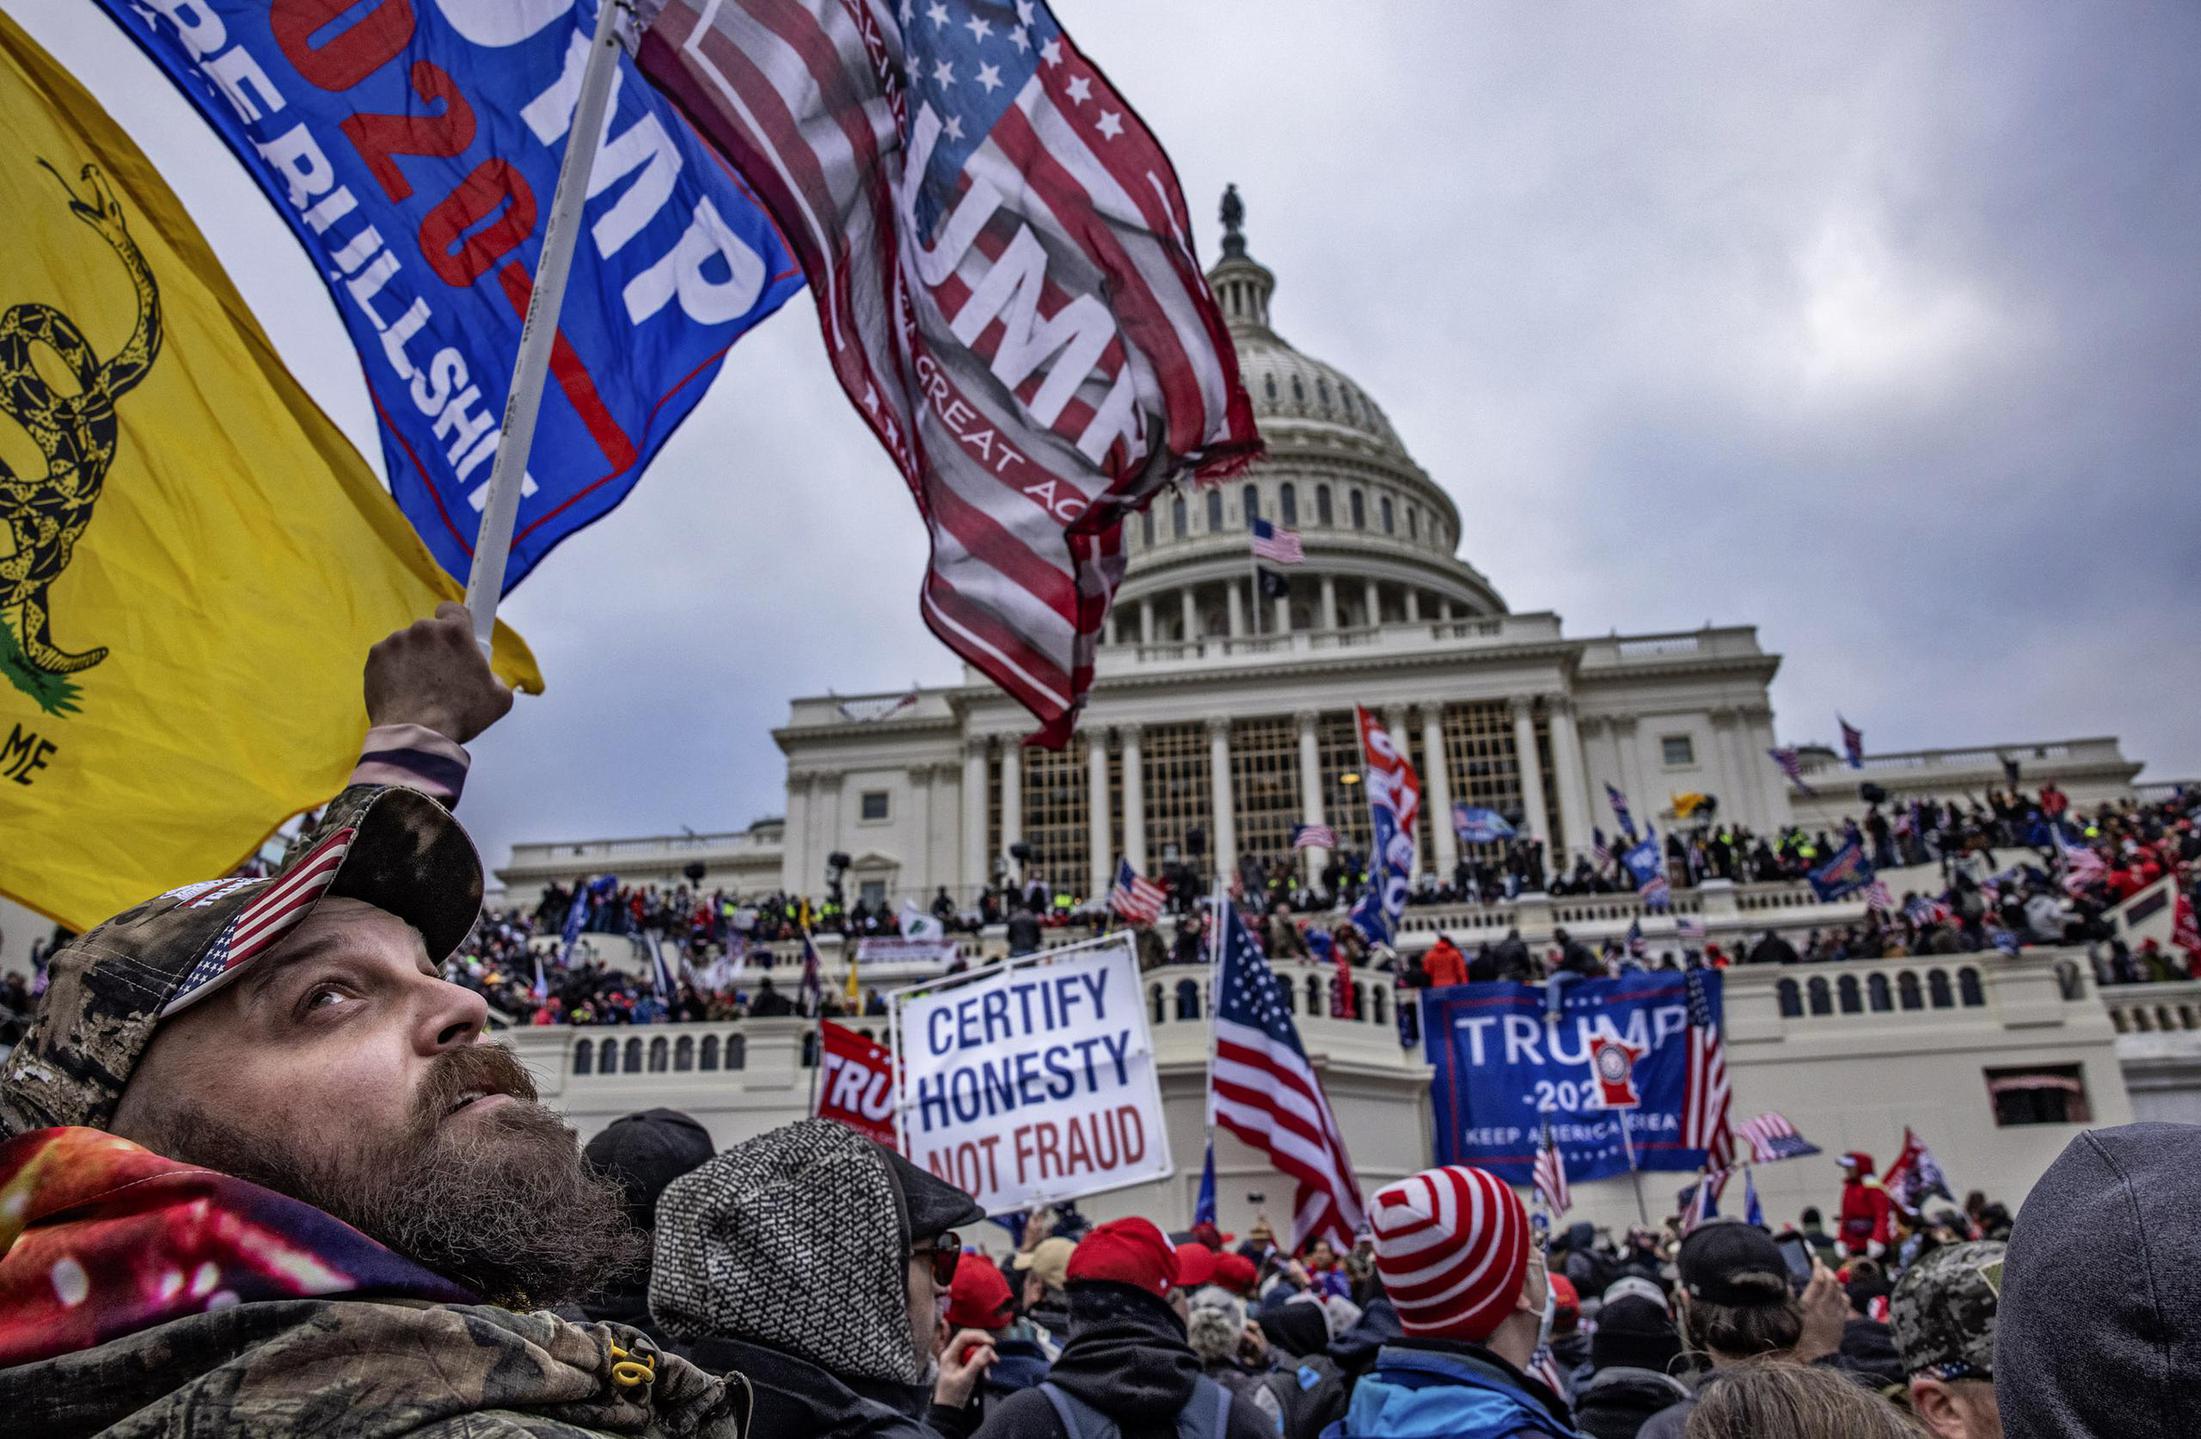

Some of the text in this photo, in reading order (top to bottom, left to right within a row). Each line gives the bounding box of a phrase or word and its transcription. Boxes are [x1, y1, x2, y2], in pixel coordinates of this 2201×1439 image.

[916, 356, 1006, 472] GREAT
[0, 722, 58, 786] ME
[928, 967, 1110, 1056] CERTIFY
[917, 1029, 1132, 1132] HONESTY
[927, 1104, 1147, 1201] NOT FRAUD
[1465, 1126, 1521, 1146] KEEP
